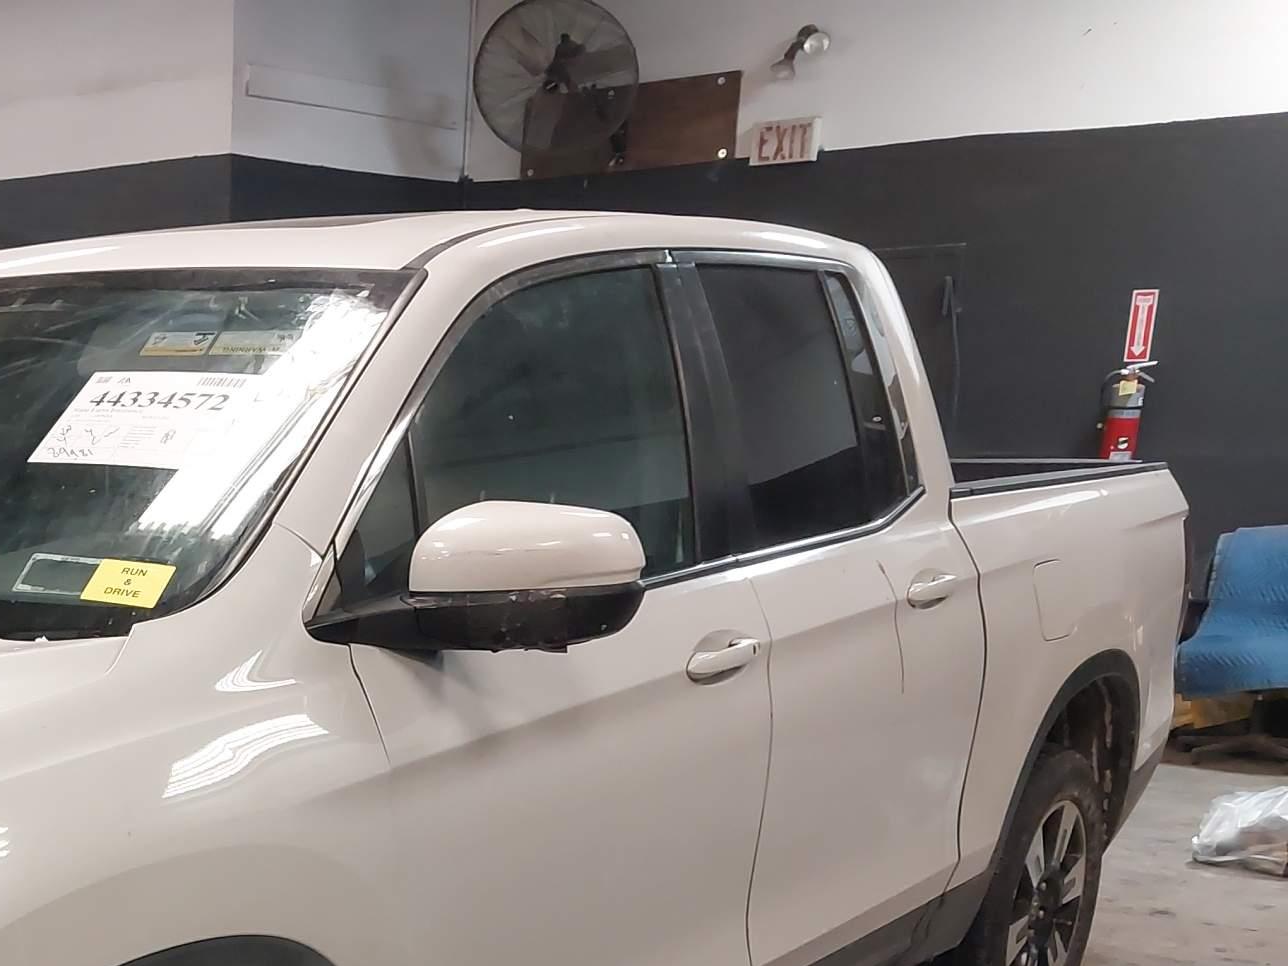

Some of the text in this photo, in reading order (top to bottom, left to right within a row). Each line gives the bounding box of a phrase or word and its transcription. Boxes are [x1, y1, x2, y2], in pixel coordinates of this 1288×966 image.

[758, 122, 813, 161] EXIT
[89, 390, 231, 411] 44334572
[120, 567, 148, 577] RUN
[123, 578, 132, 586] &
[103, 586, 142, 598] DRIVE
